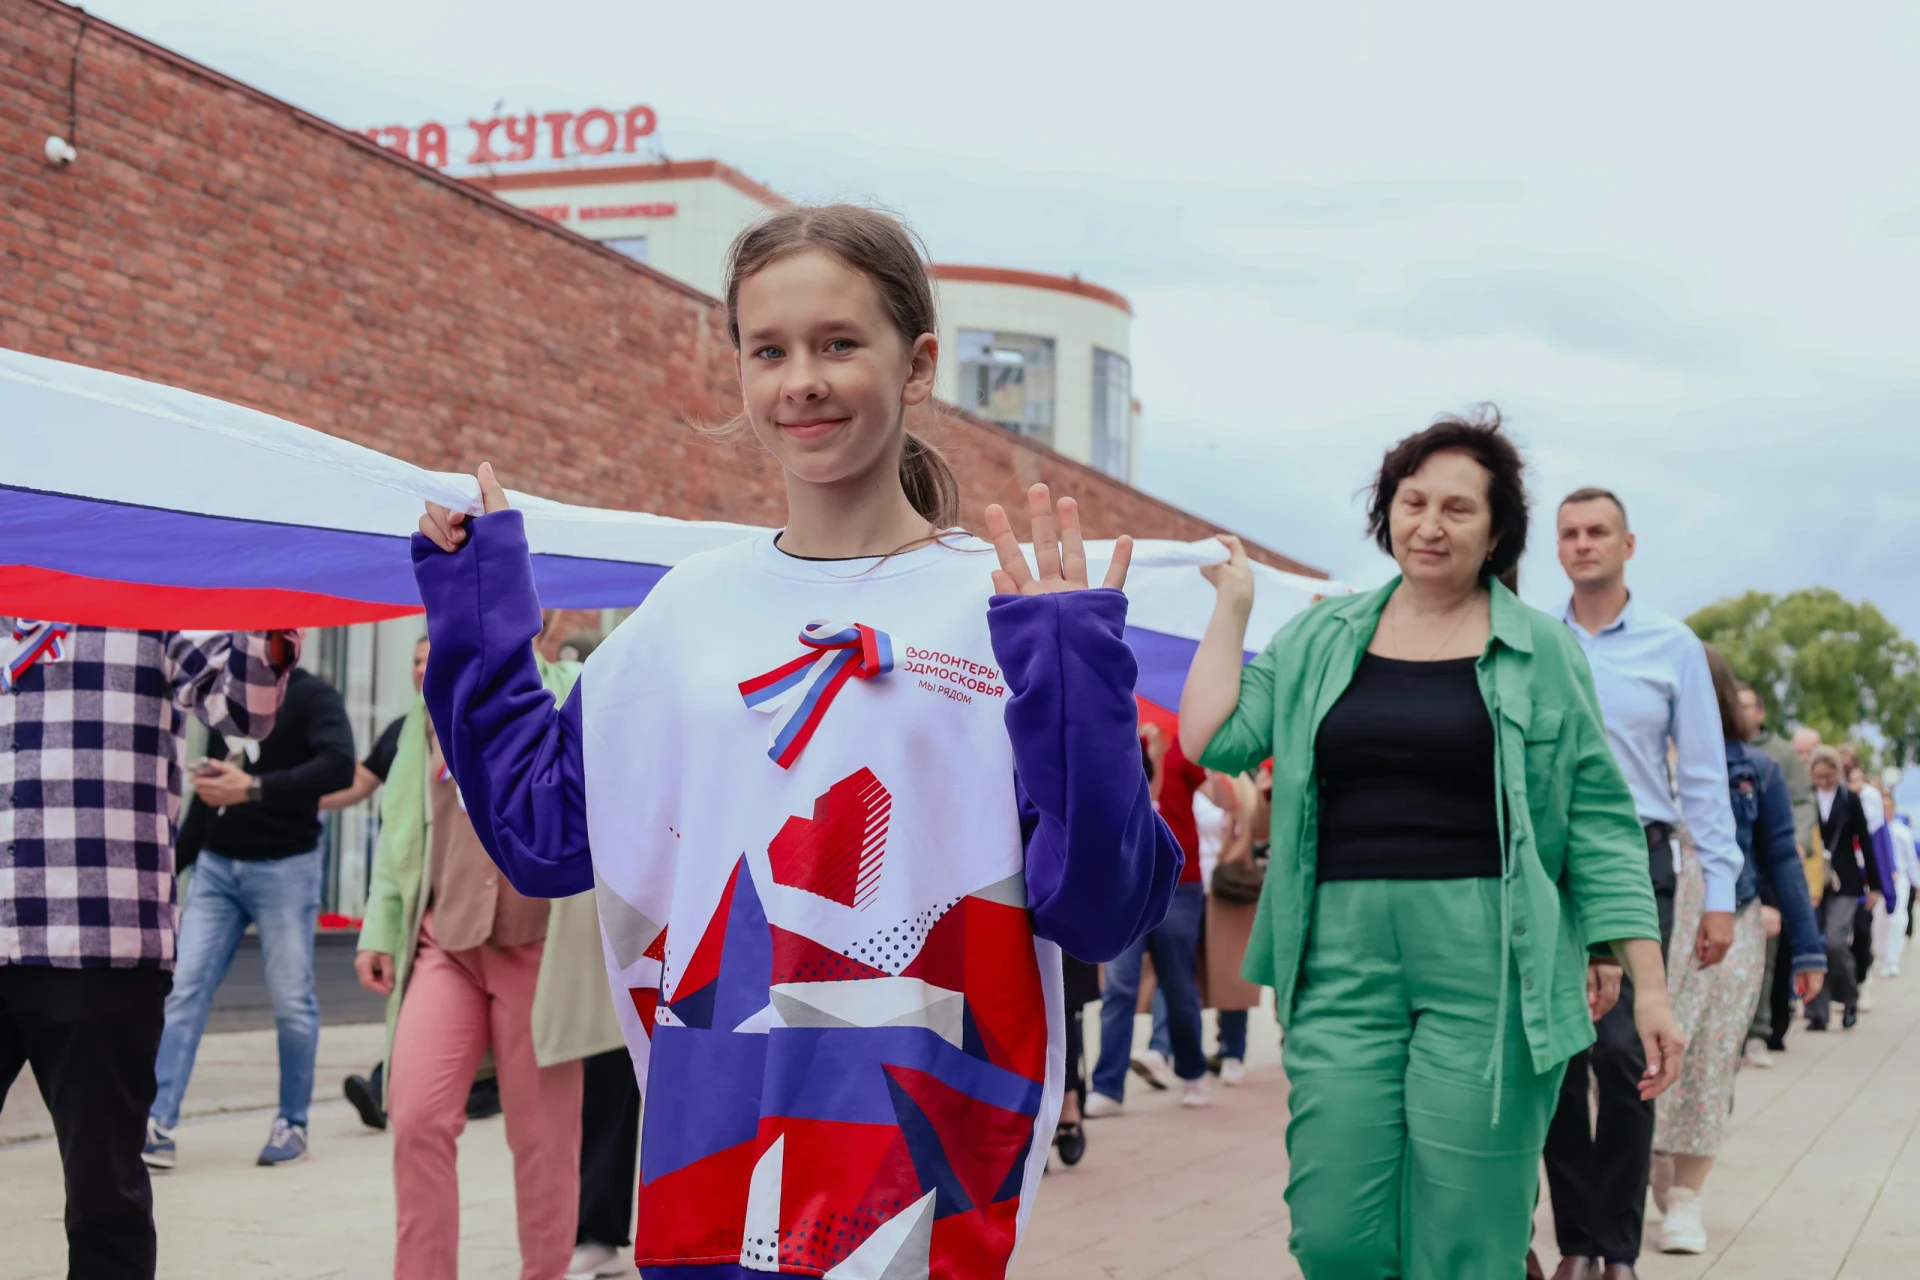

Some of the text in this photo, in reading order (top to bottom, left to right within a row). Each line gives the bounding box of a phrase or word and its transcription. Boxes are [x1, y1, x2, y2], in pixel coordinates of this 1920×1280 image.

[467, 104, 656, 164] ХУТОР
[903, 661, 1004, 698] ОДМОСКОВЬЯ
[906, 646, 1000, 680] ВОЛОНТЕРЫ
[918, 680, 972, 705] МЫ РЯДОМ
